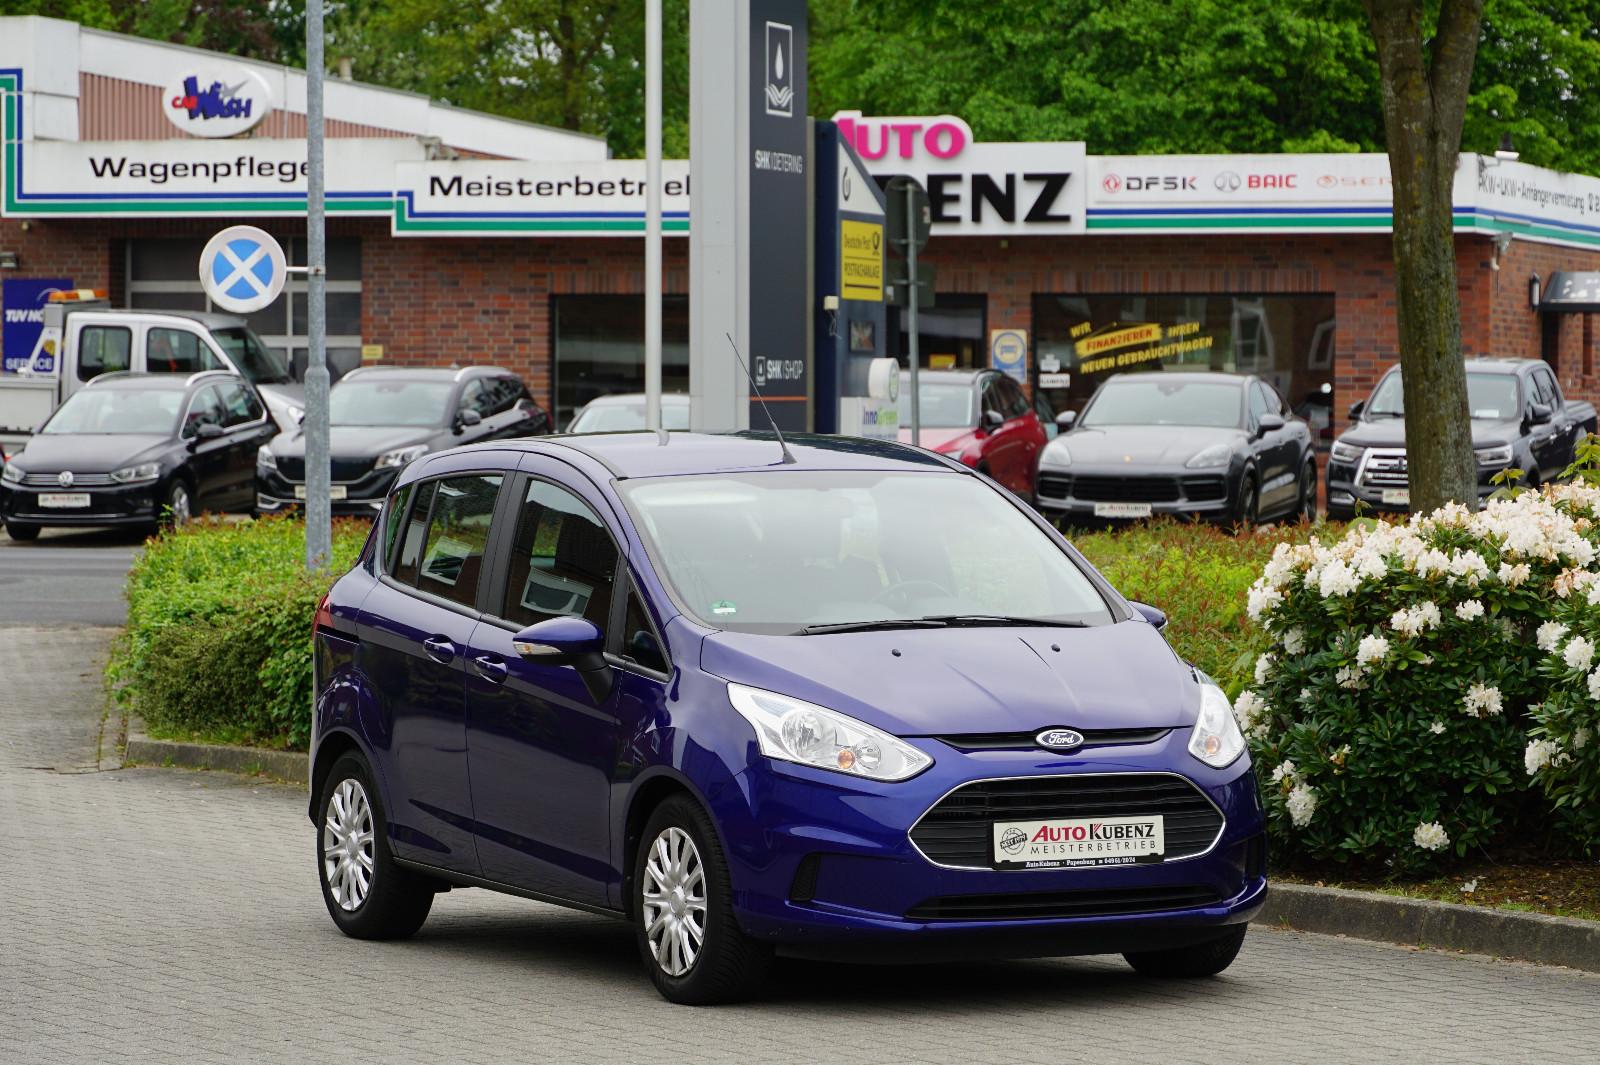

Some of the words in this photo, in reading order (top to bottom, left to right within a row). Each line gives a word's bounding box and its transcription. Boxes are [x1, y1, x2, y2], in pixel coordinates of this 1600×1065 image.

[429, 174, 690, 197] Meisterbetre
[1126, 176, 1196, 190] DFSK
[1247, 174, 1297, 189] BAIC
[1070, 321, 1092, 338] WIR
[1086, 327, 1153, 351] FINANZIEREN
[1167, 321, 1200, 338] IHREN
[5, 357, 53, 370] SERICE
[1081, 357, 1116, 375] NEUEN
[1117, 336, 1213, 367] GEBRAUCHTWAGEN
[767, 359, 782, 379] SHK
[785, 360, 803, 379] SHOP
[1048, 732, 1075, 744] Ford
[1031, 825, 1086, 842] AUTO
[1089, 823, 1155, 840] KUBENZ
[1030, 840, 1156, 855] MEISTERBETRIEB
